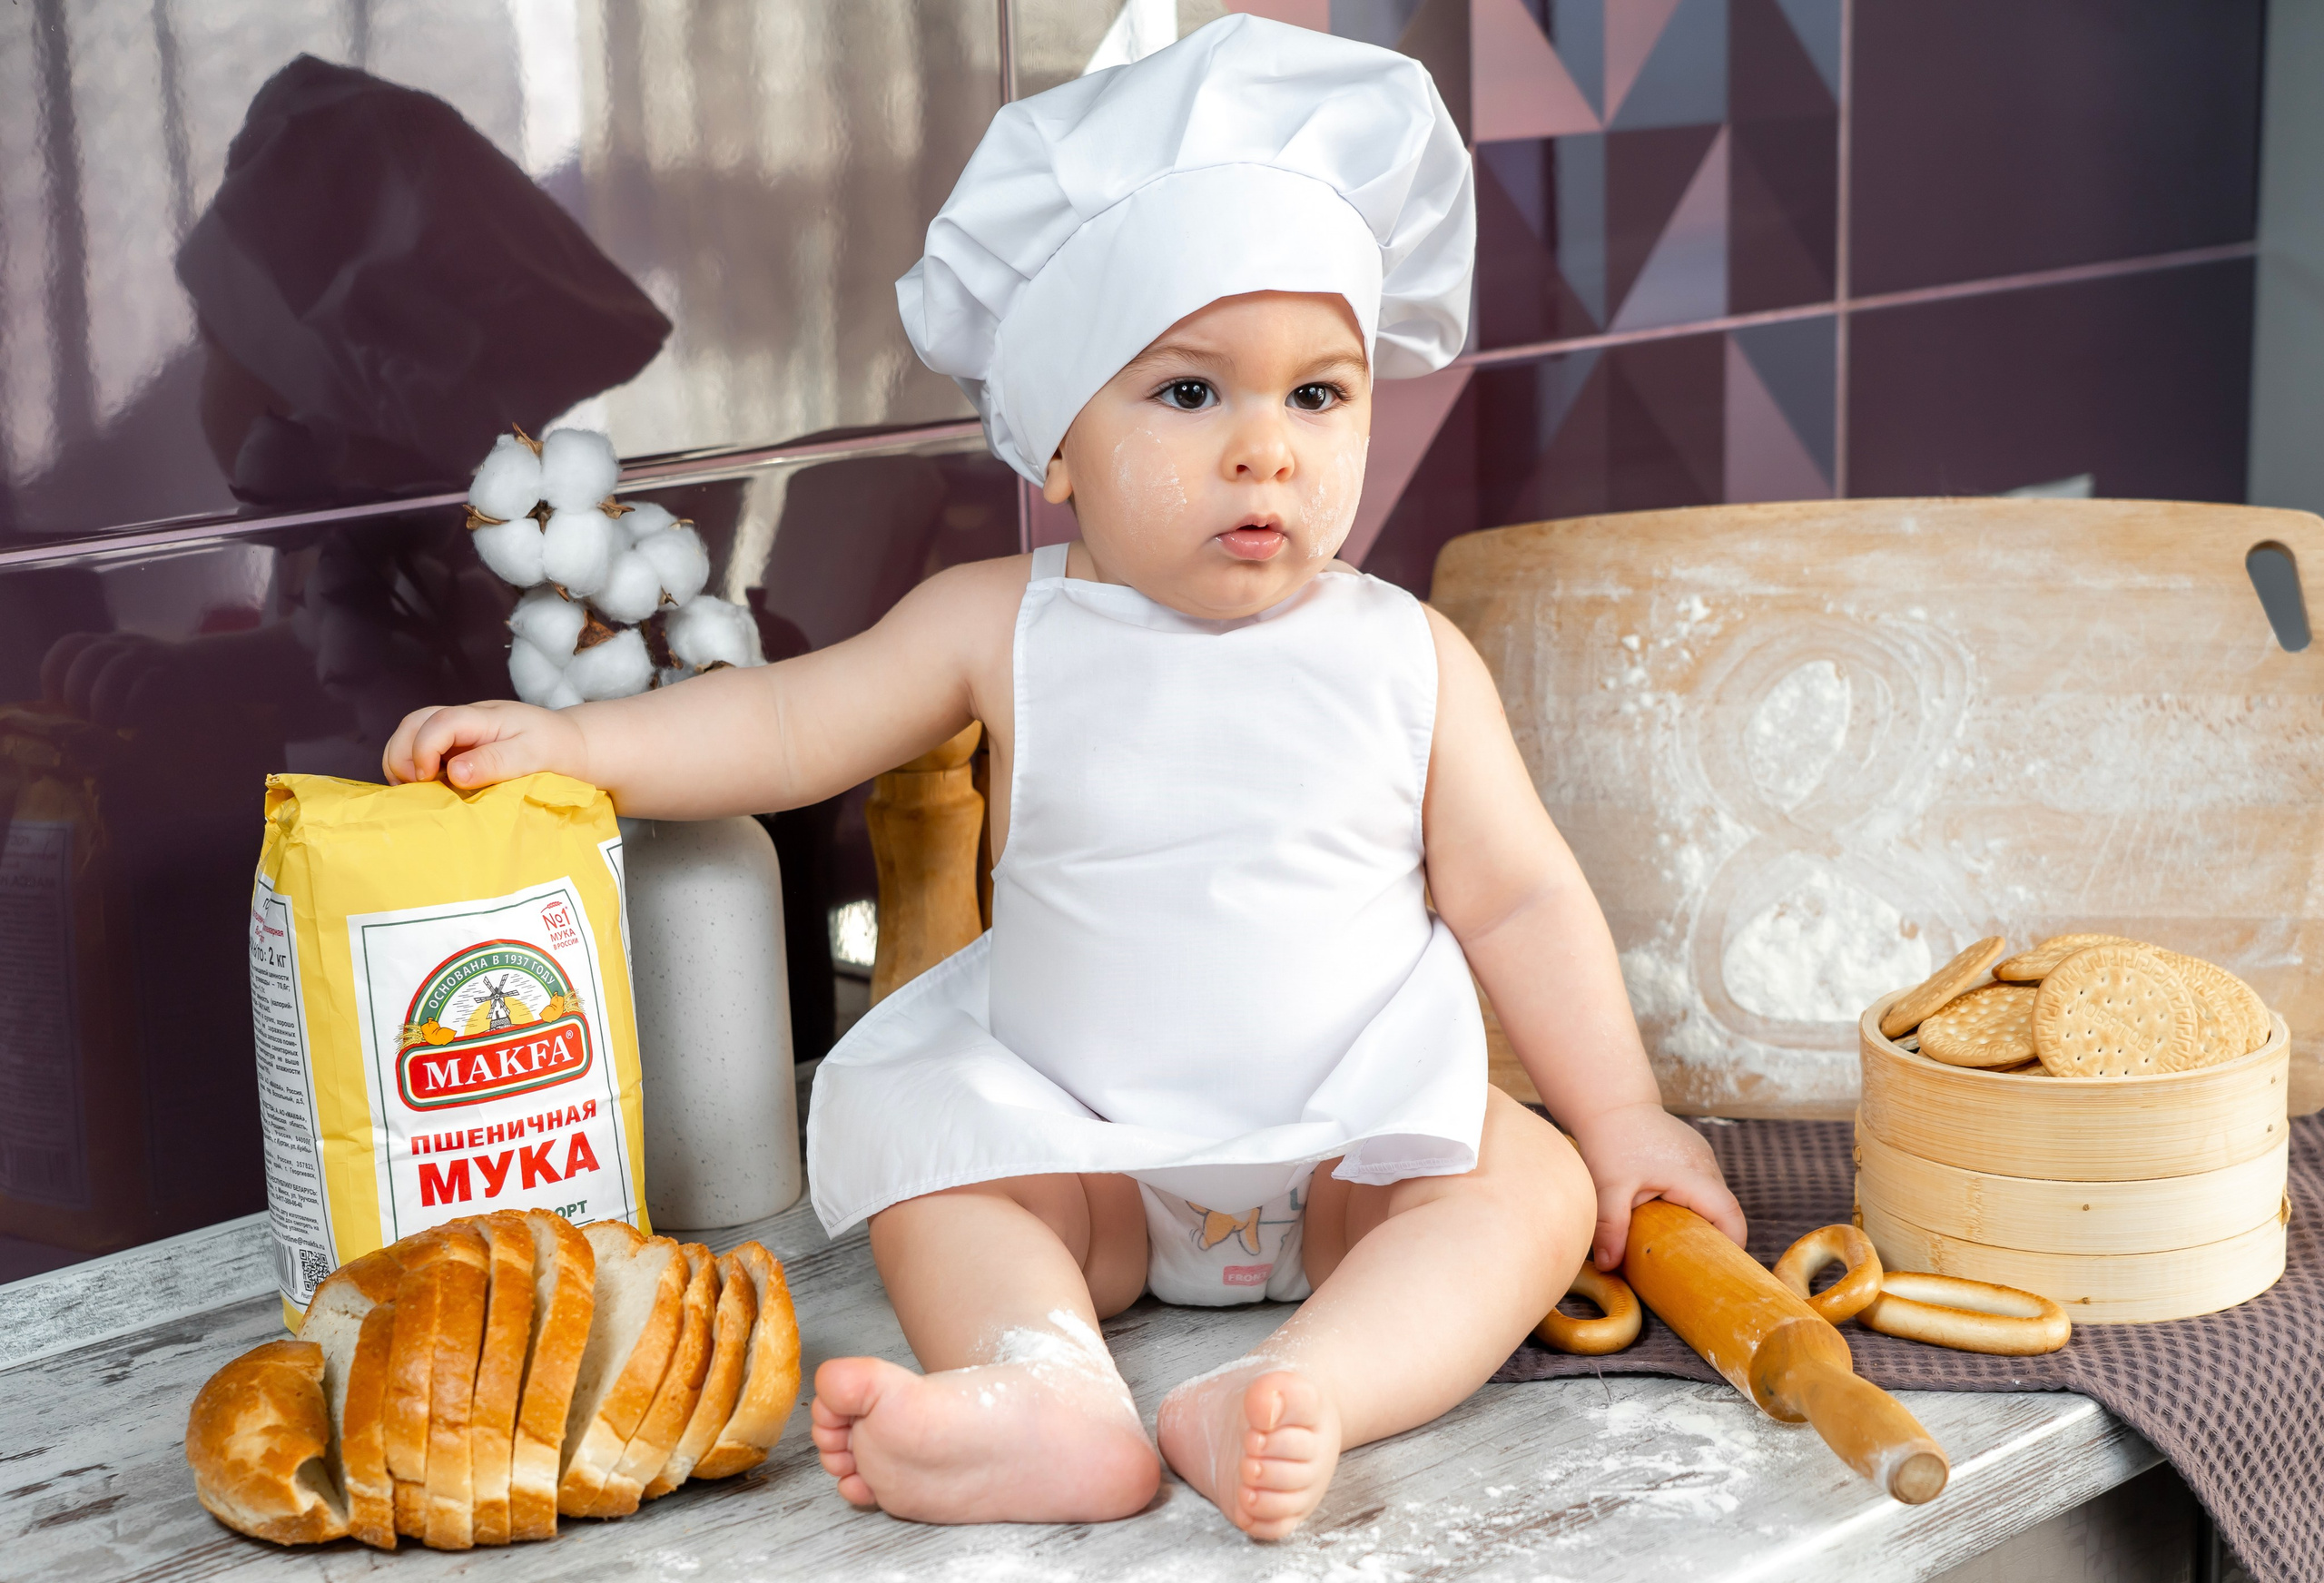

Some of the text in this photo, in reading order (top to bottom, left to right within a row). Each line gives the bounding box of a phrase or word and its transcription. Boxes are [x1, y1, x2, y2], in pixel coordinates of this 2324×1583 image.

[550, 928, 576, 942] МУКА
[557, 938, 578, 949] РОССИИ
[269, 946, 274, 966] 2
[428, 954, 556, 1008] ОСНОВАНА В 1937 ГОДУ
[423, 1035, 574, 1091] MAKFA
[410, 1098, 597, 1155] ПШЕНИЧНАЯ
[418, 1131, 601, 1208] МУКА
[555, 1200, 587, 1218] ОРТ
